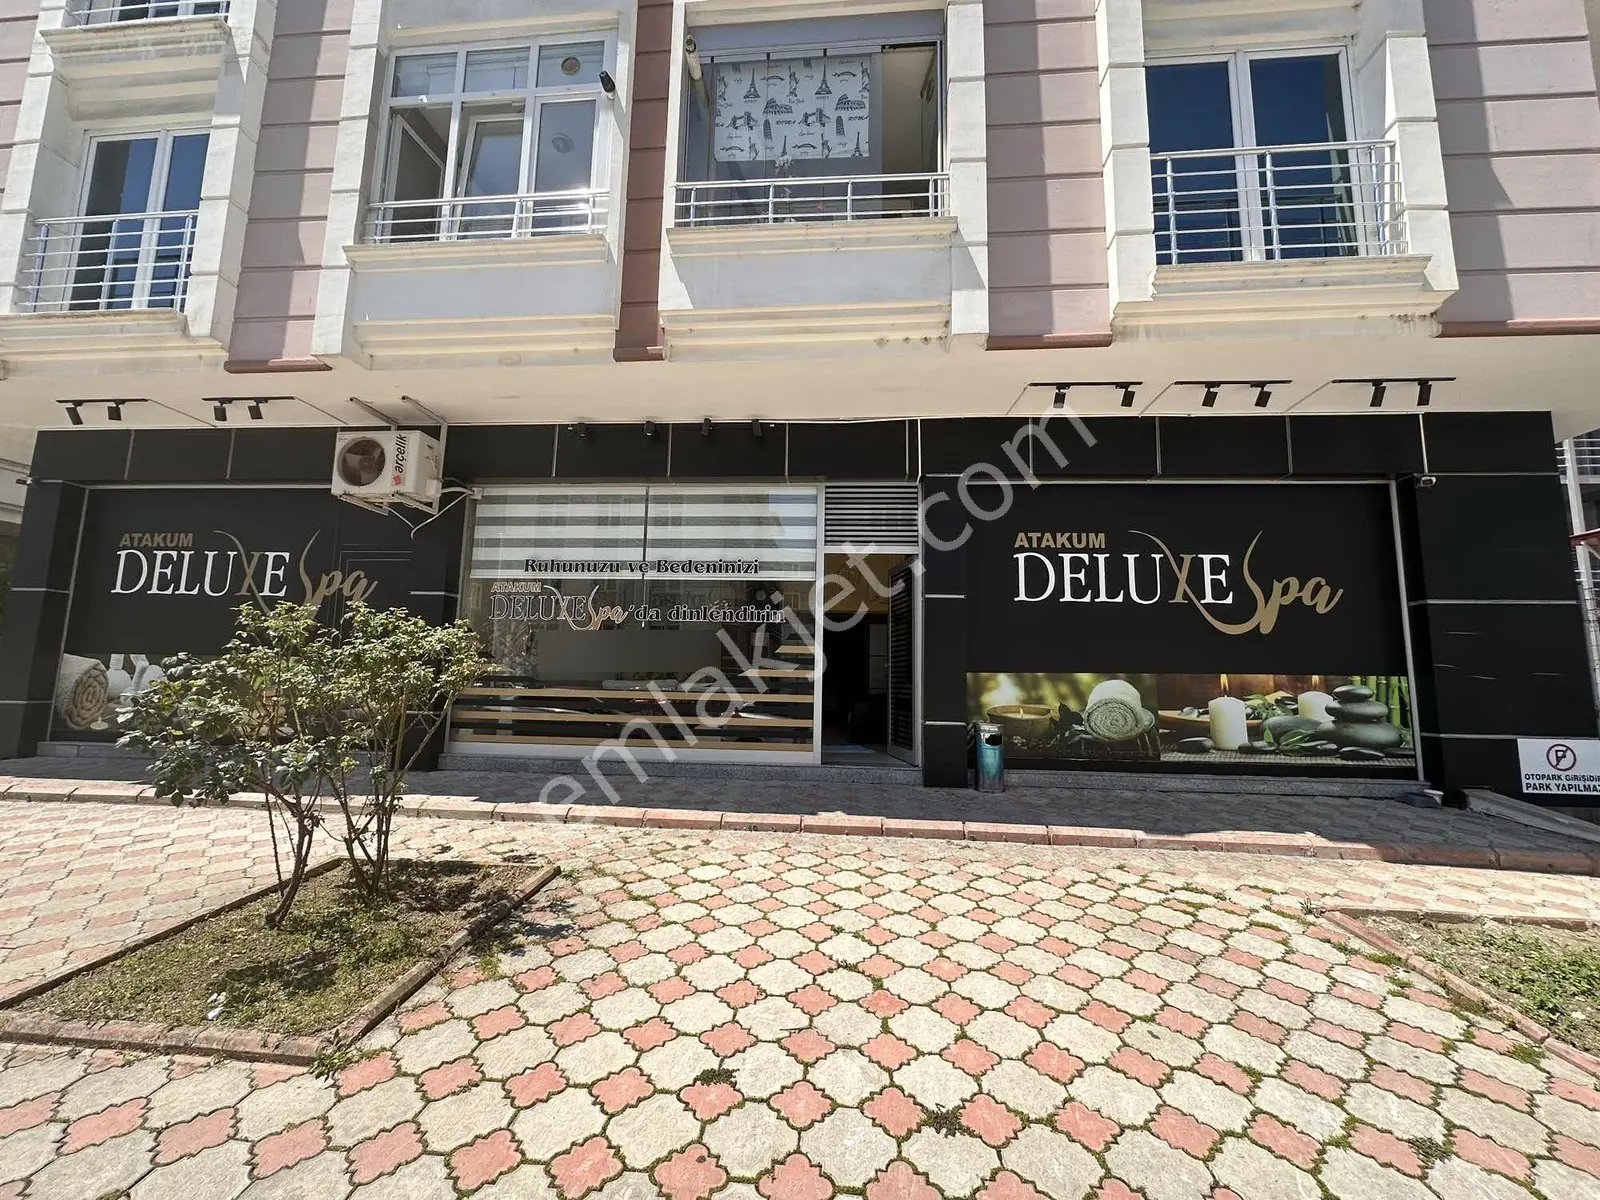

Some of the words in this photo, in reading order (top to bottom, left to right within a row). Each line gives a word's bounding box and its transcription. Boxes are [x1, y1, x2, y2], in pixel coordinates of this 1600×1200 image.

[394, 434, 408, 473] arçelik
[118, 532, 194, 548] ATAKUM
[1013, 532, 1106, 549] ATAKUM
[111, 530, 291, 613] DELUXE
[298, 529, 379, 613] Spa
[524, 558, 620, 573] Ruhunuzu
[628, 561, 650, 573] ve
[656, 558, 760, 575] Bedeninizi
[490, 581, 541, 593] ATAKUM
[1013, 529, 1234, 620] DELUXE
[1240, 529, 1344, 635] Spa
[488, 585, 588, 629] DELUXE
[667, 604, 786, 623] dinlendirin
[1524, 773, 1563, 781] OTOPARK
[1525, 782, 1553, 792] PARK
